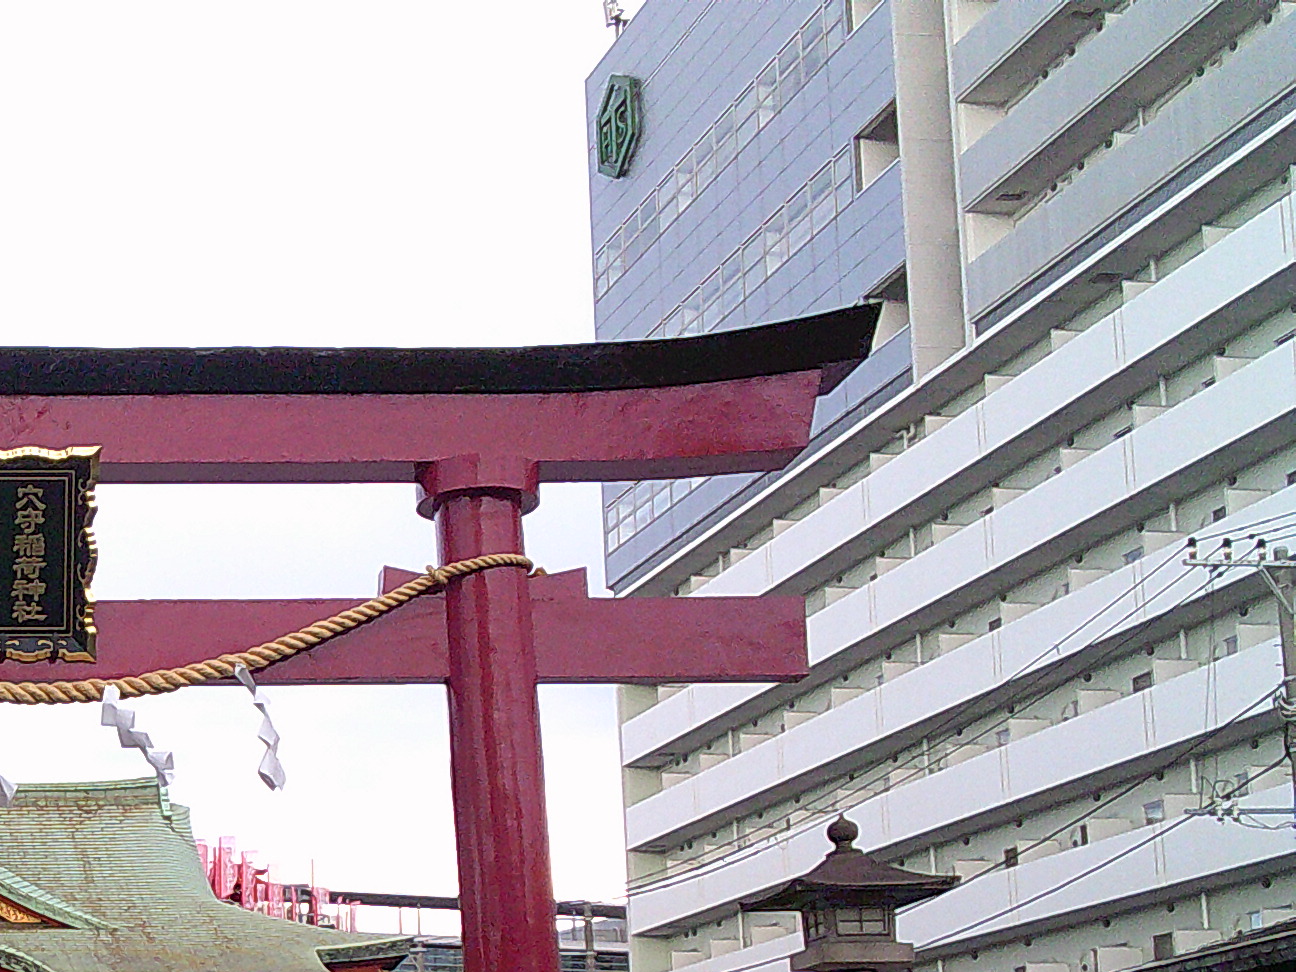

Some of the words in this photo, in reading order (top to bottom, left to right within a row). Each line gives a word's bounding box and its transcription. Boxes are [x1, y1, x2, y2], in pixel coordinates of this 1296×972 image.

[11, 484, 48, 624] 穴守稲荷神社
